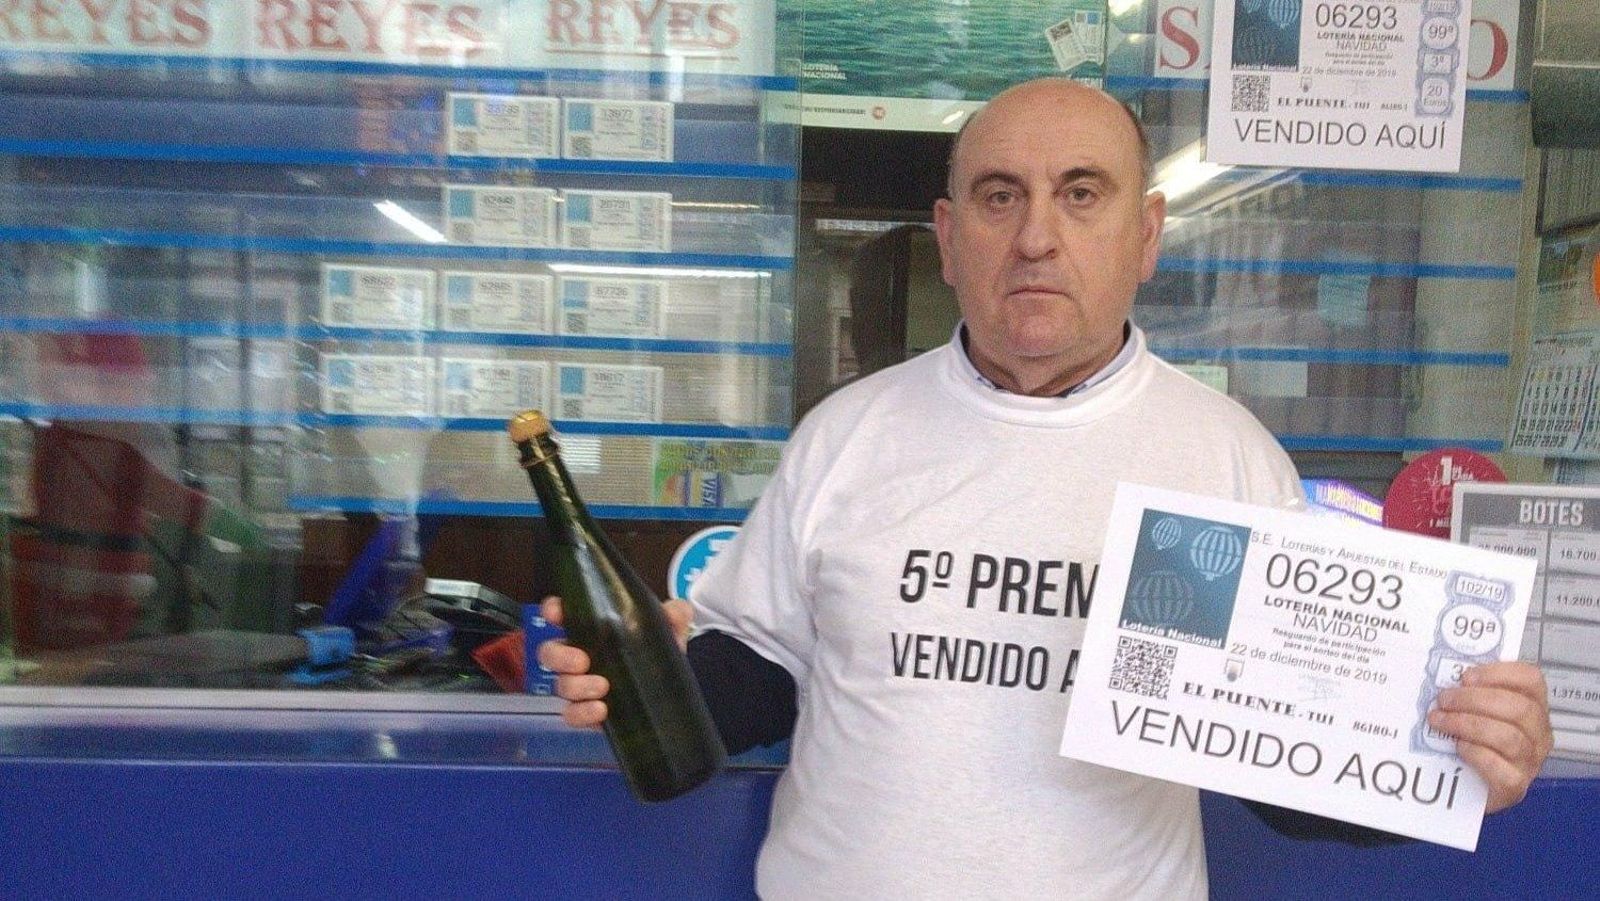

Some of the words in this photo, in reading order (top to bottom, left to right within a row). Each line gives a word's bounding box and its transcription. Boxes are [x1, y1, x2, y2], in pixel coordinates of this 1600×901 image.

[256, 0, 488, 57] REYES
[545, 0, 741, 50] REYES
[1315, 3, 1397, 30] 06293
[1336, 40, 1388, 51] NAVIDAD
[1277, 97, 1290, 106] EL
[1296, 98, 1346, 108] PUENTE
[1428, 85, 1443, 97] 20
[1235, 118, 1367, 147] VENDIDO
[1375, 120, 1446, 149] AQUÍ
[701, 478, 719, 507] VISA
[1519, 499, 1584, 526] BOTES
[899, 549, 954, 604] 5º
[1266, 553, 1403, 610] 06293
[1459, 580, 1502, 598] 102/19
[1264, 595, 1328, 617] LOTERÍA
[1332, 608, 1410, 634] NACIONAL
[1293, 613, 1378, 643] NAVIDAD
[1453, 615, 1496, 640] 99ª
[1168, 627, 1223, 648] Nacional
[1283, 641, 1302, 651] para
[1313, 647, 1340, 658] sorteo
[1341, 652, 1356, 661] del
[1318, 637, 1329, 645] de
[890, 631, 1050, 691] VENDIDO
[1230, 643, 1248, 656] 22
[1250, 647, 1266, 660] de
[1269, 651, 1332, 674] diciembre
[1334, 664, 1351, 677] de
[1354, 667, 1388, 685] 2019
[1553, 686, 1600, 701] 1.375.00
[1183, 681, 1206, 697] EL
[1213, 688, 1297, 717] PUENTE
[1307, 710, 1334, 725] TUI
[1352, 720, 1399, 738] 86180-1
[1112, 700, 1323, 777] VENDIDO
[1333, 752, 1462, 810] AQUÍ
